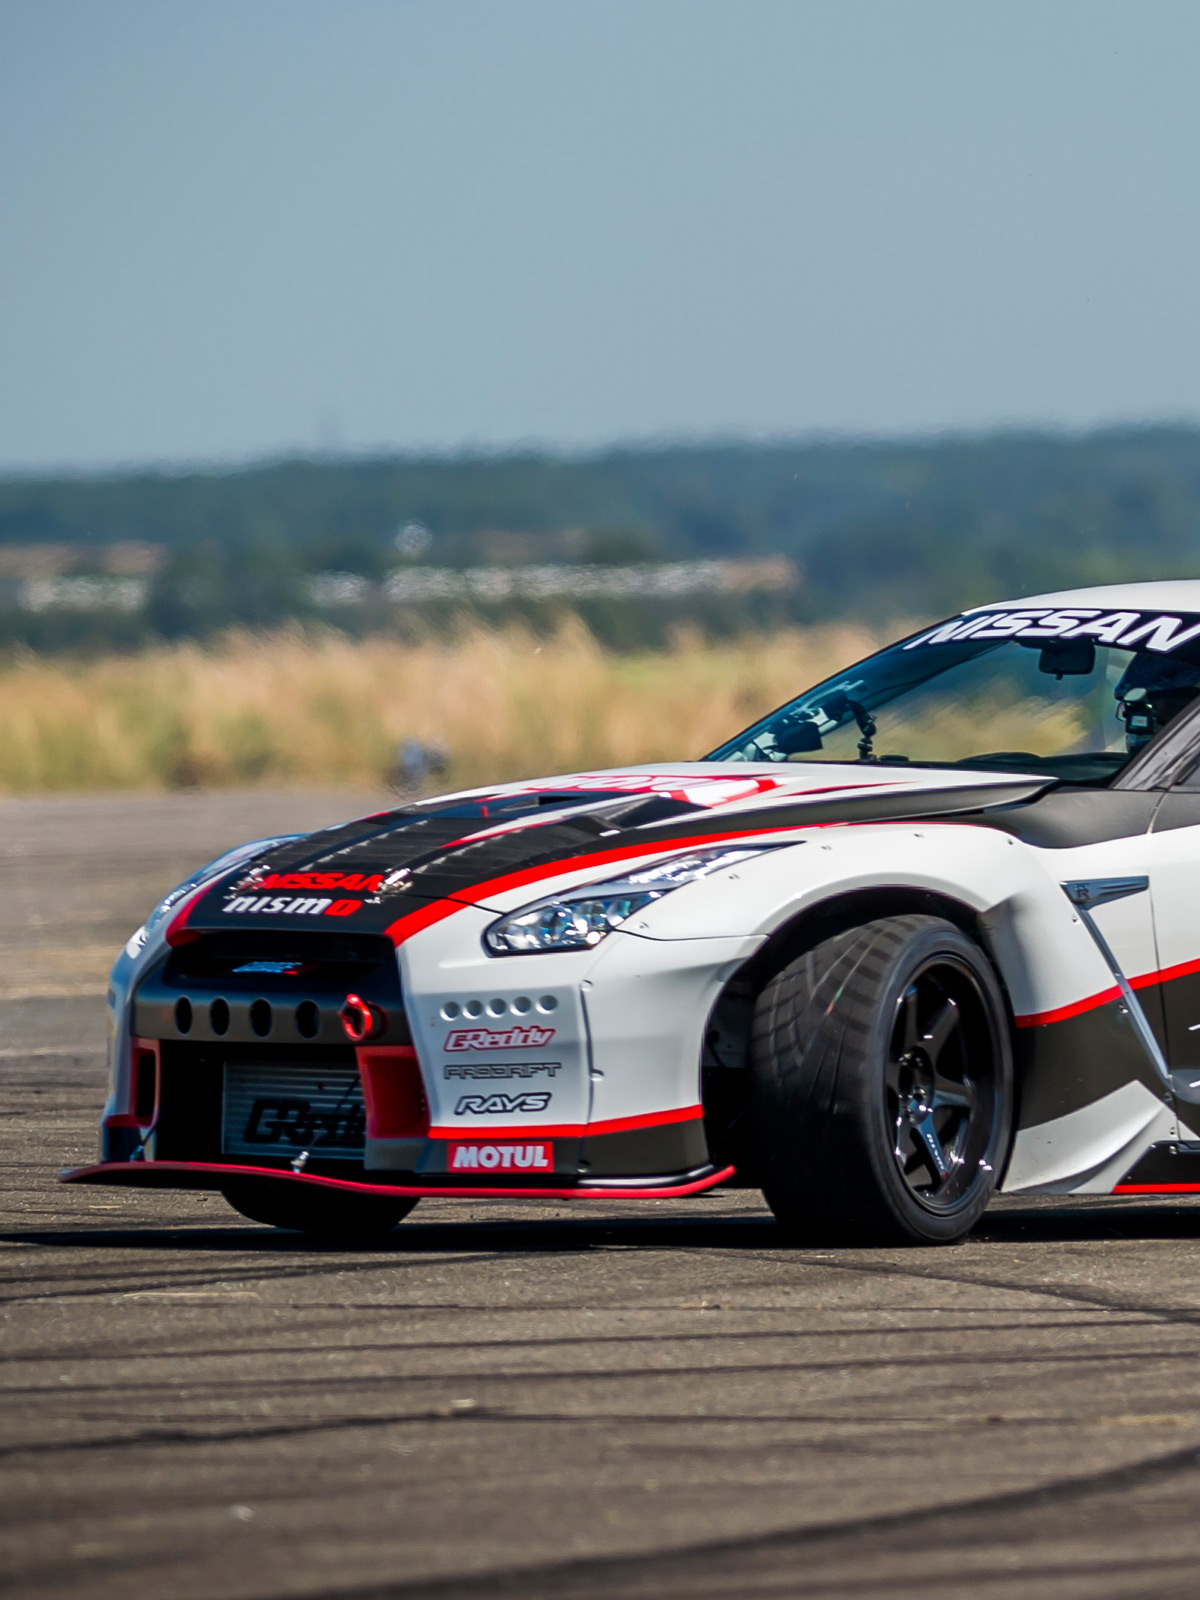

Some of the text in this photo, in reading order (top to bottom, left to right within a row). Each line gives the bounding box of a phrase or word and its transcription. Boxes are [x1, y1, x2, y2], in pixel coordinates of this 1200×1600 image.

[221, 896, 363, 917] nismo
[443, 1025, 556, 1052] GReddy
[454, 1092, 552, 1115] RAYS
[452, 1145, 549, 1168] MOTUL
